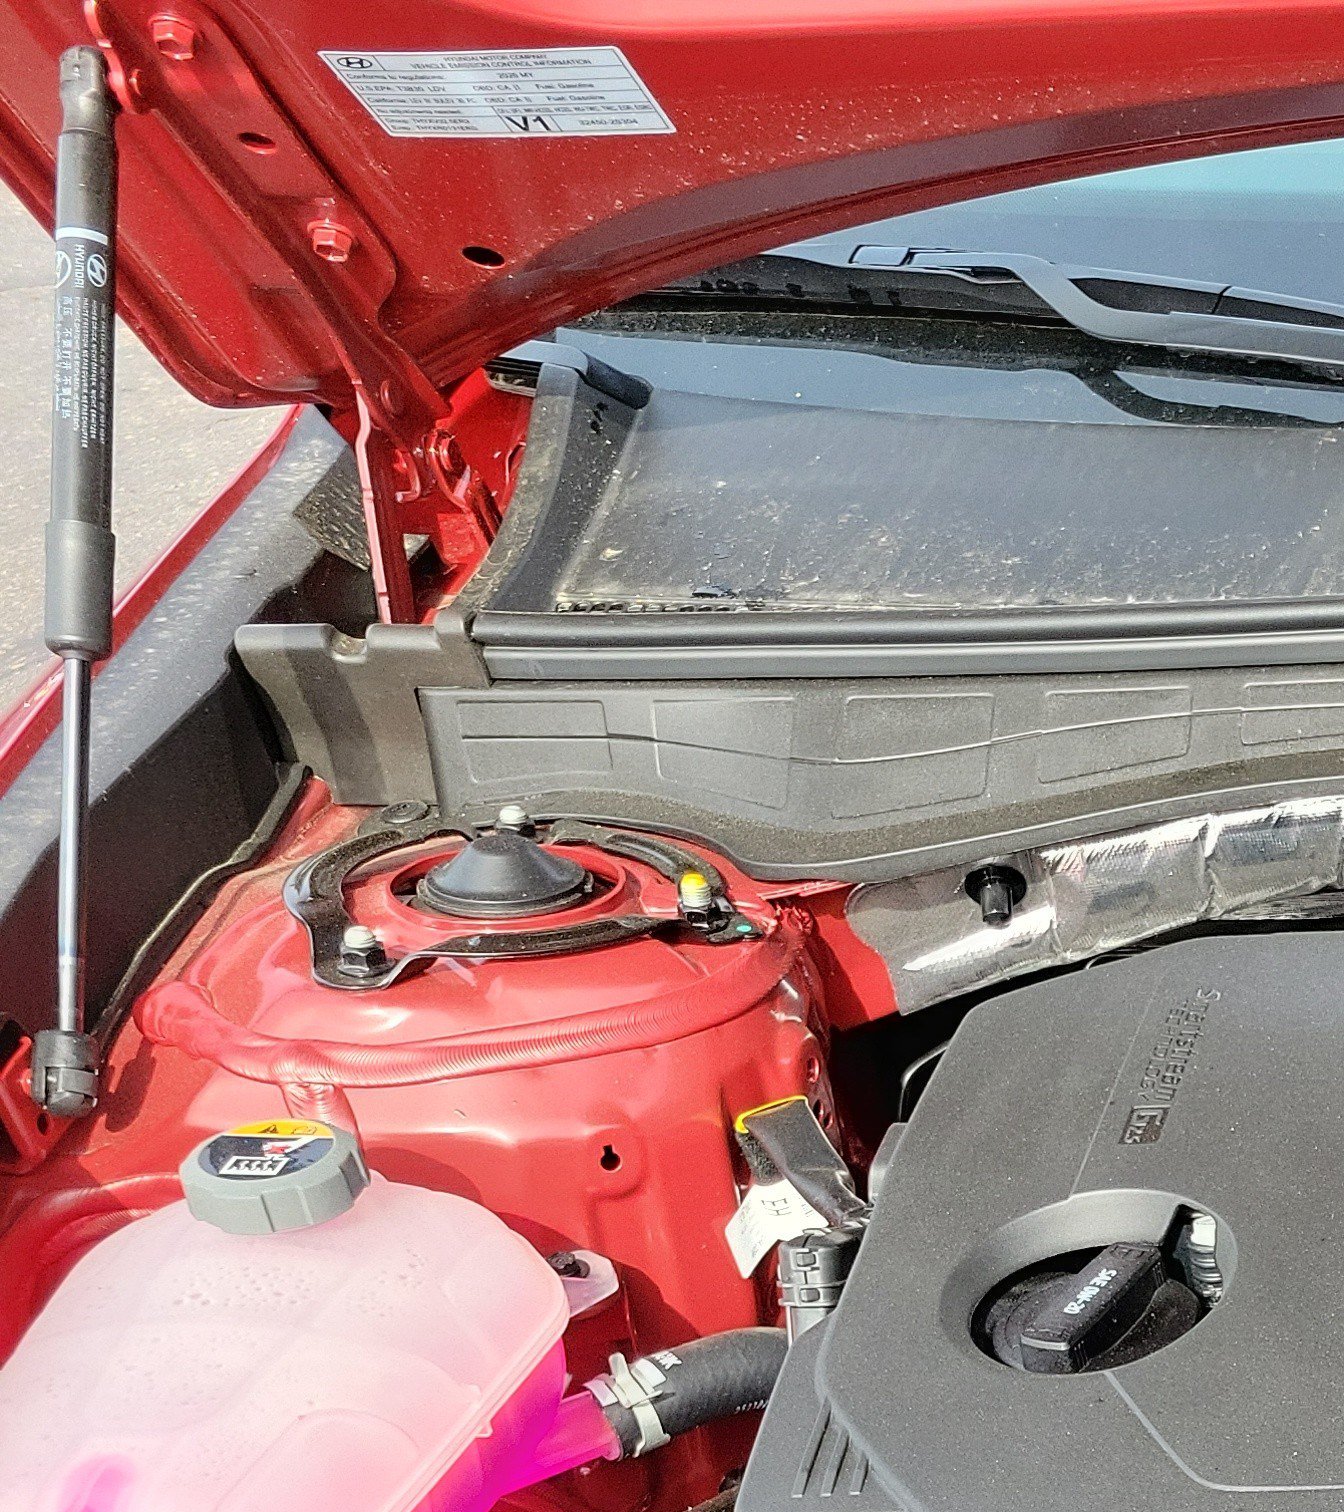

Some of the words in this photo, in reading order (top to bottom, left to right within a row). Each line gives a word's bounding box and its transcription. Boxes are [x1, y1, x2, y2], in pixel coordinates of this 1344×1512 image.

[449, 61, 490, 69] EMISSION
[491, 60, 533, 68] CONTROL
[534, 59, 592, 67] INFORMATION
[505, 115, 551, 132] V1
[73, 243, 85, 289] HYUNDAI
[1087, 1268, 1119, 1294] SAE
[1062, 1282, 1101, 1318] 0W-20
